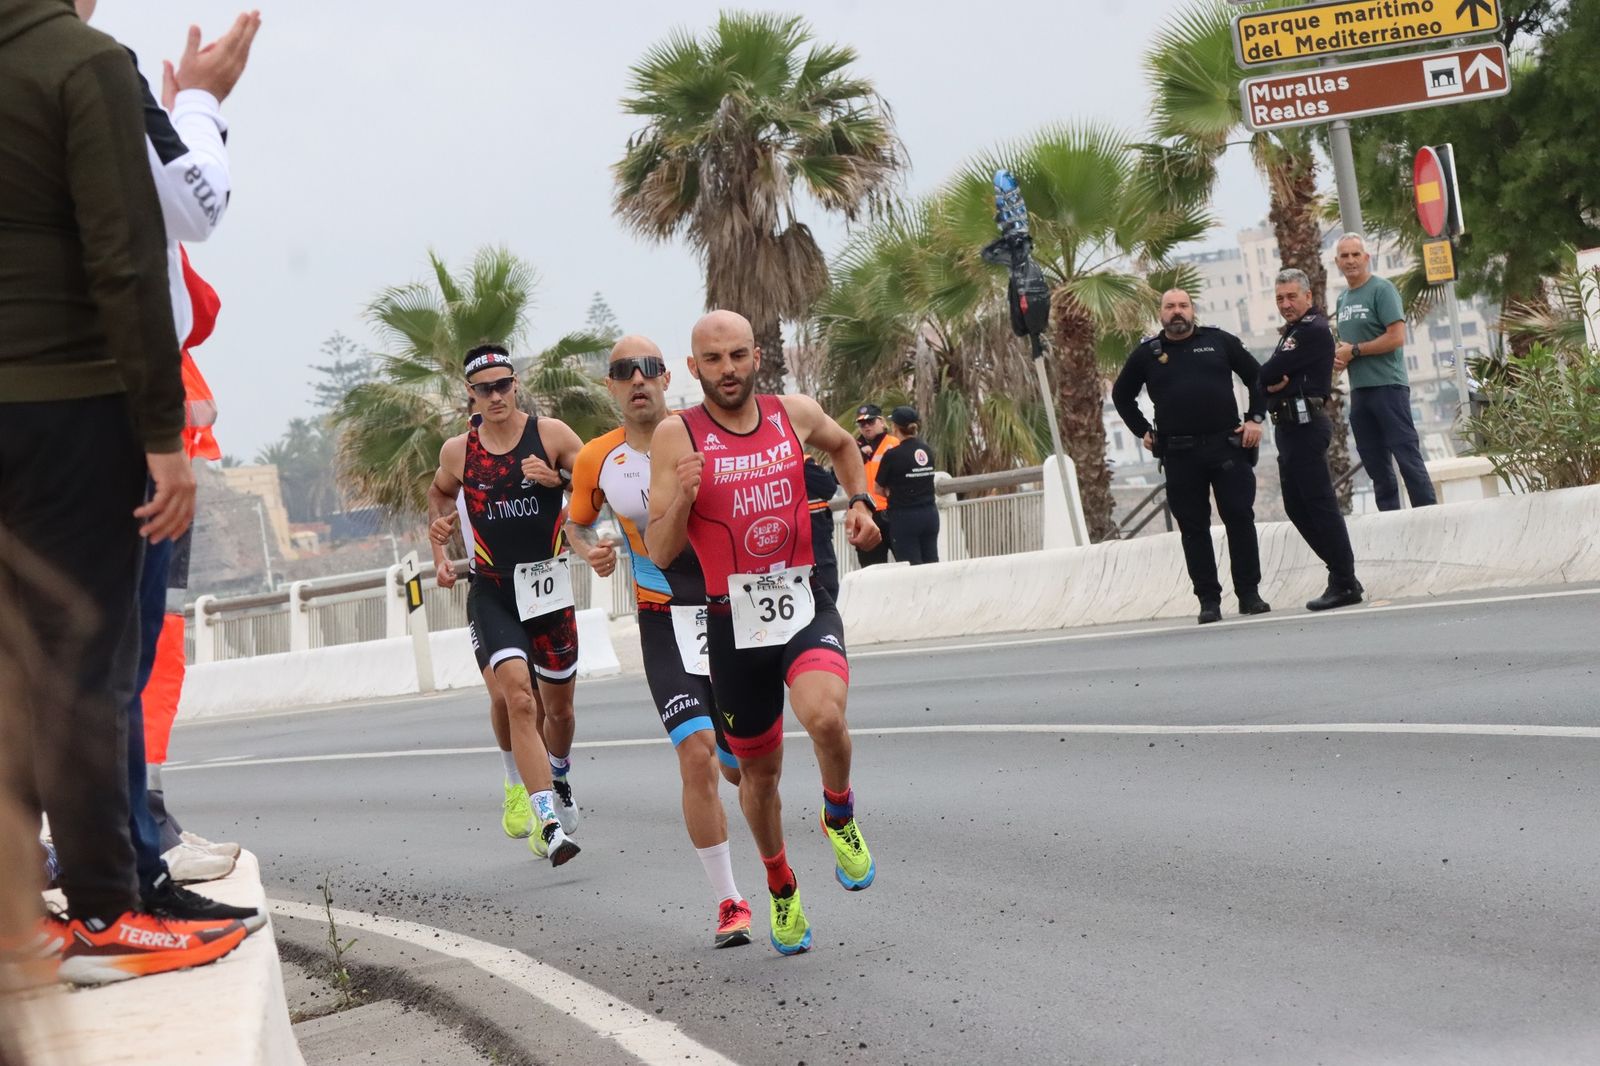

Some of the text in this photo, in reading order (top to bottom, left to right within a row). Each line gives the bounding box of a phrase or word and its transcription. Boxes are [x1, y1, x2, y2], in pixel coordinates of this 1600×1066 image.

[1243, 0, 1434, 41] parque marítimo
[1247, 21, 1442, 60] del Mediterráneo
[1251, 76, 1350, 103] Murallas
[1254, 100, 1330, 124] Reales
[714, 440, 792, 473] ISBILYA
[713, 462, 784, 485] TRIATHLON
[487, 496, 539, 520] J. TINOCO
[732, 478, 792, 518] AHMED
[406, 559, 413, 571] 1
[531, 576, 554, 598] 10
[759, 594, 795, 622] 36
[118, 923, 192, 950] TERREX
